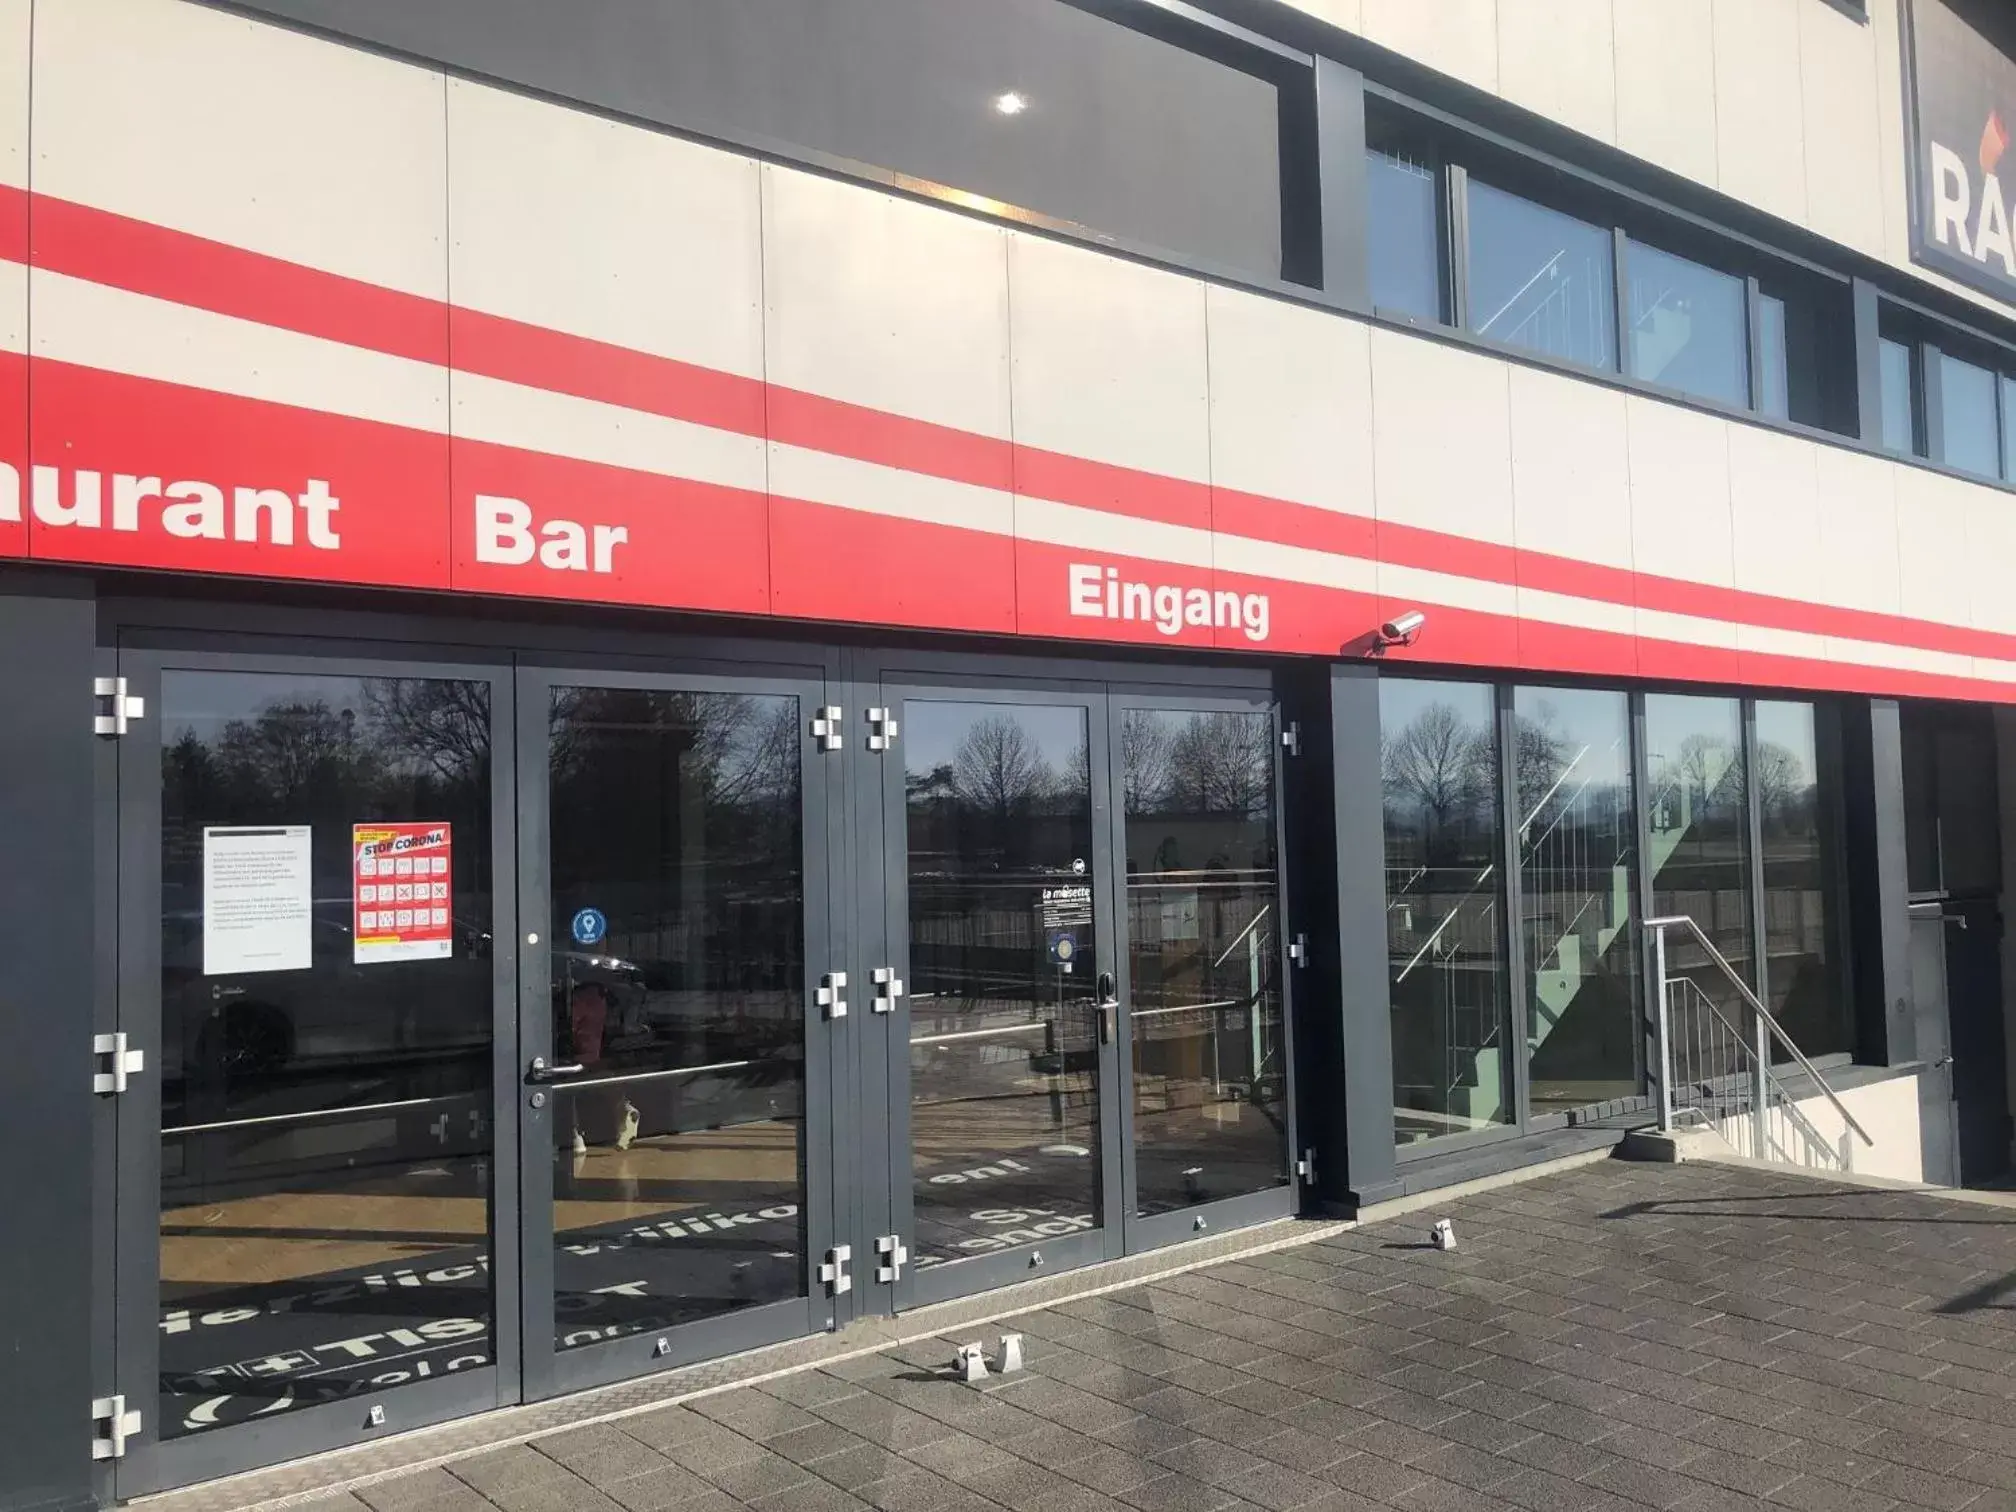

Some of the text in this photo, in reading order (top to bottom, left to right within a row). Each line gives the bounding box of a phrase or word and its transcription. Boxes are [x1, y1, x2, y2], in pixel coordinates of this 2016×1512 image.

[1931, 141, 2016, 278] RA
[475, 494, 628, 574] Bar
[1068, 562, 1270, 641] Eingang
[364, 841, 394, 856] STOP
[395, 832, 443, 850] CORONA
